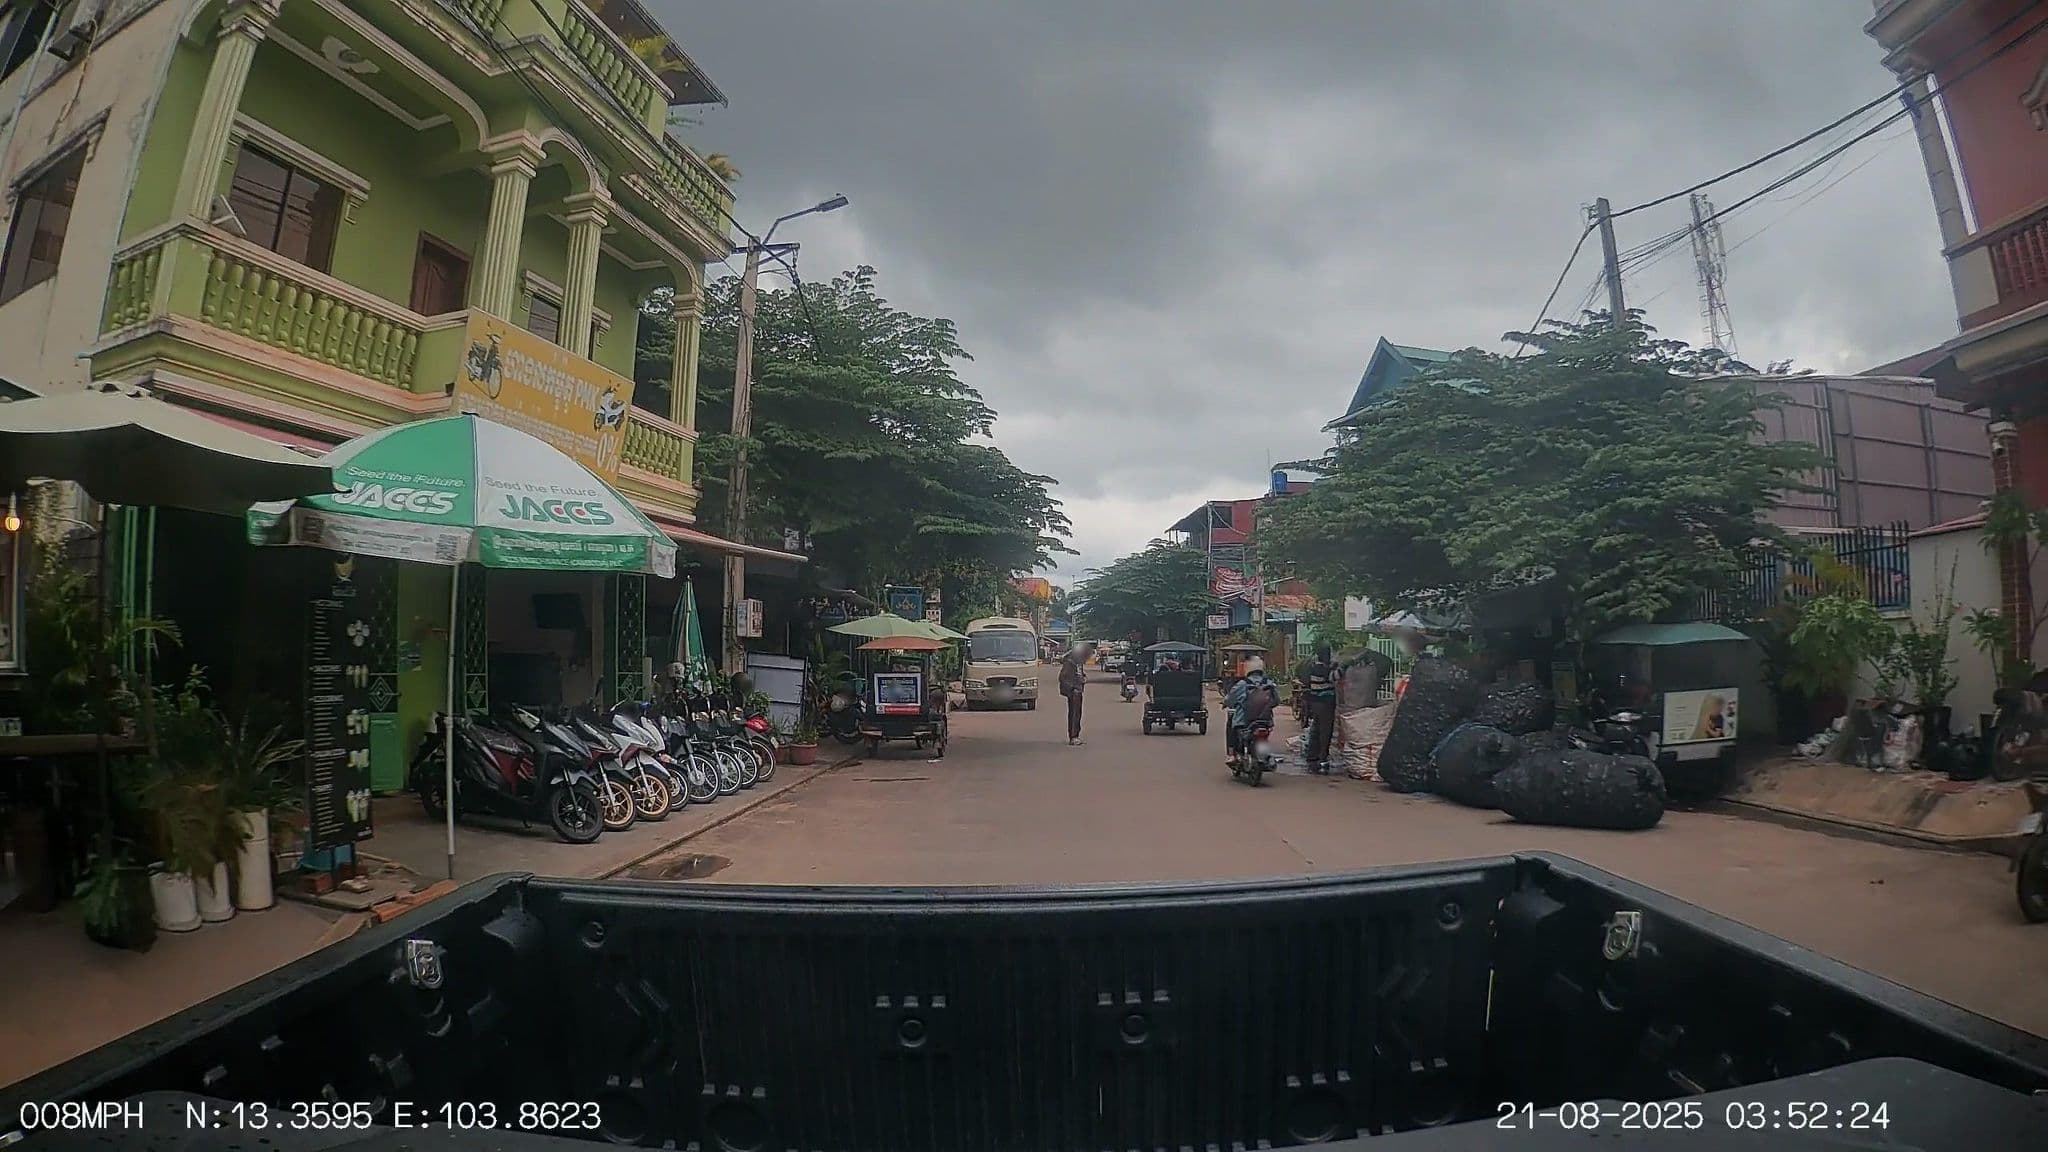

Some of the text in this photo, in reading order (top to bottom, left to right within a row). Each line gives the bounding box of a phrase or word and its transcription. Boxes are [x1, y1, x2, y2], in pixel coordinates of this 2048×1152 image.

[346, 466, 386, 480] Seed
[484, 475, 521, 490] Seed
[525, 482, 548, 493] the
[333, 480, 459, 515] JACCS
[499, 494, 615, 525] JACCS
